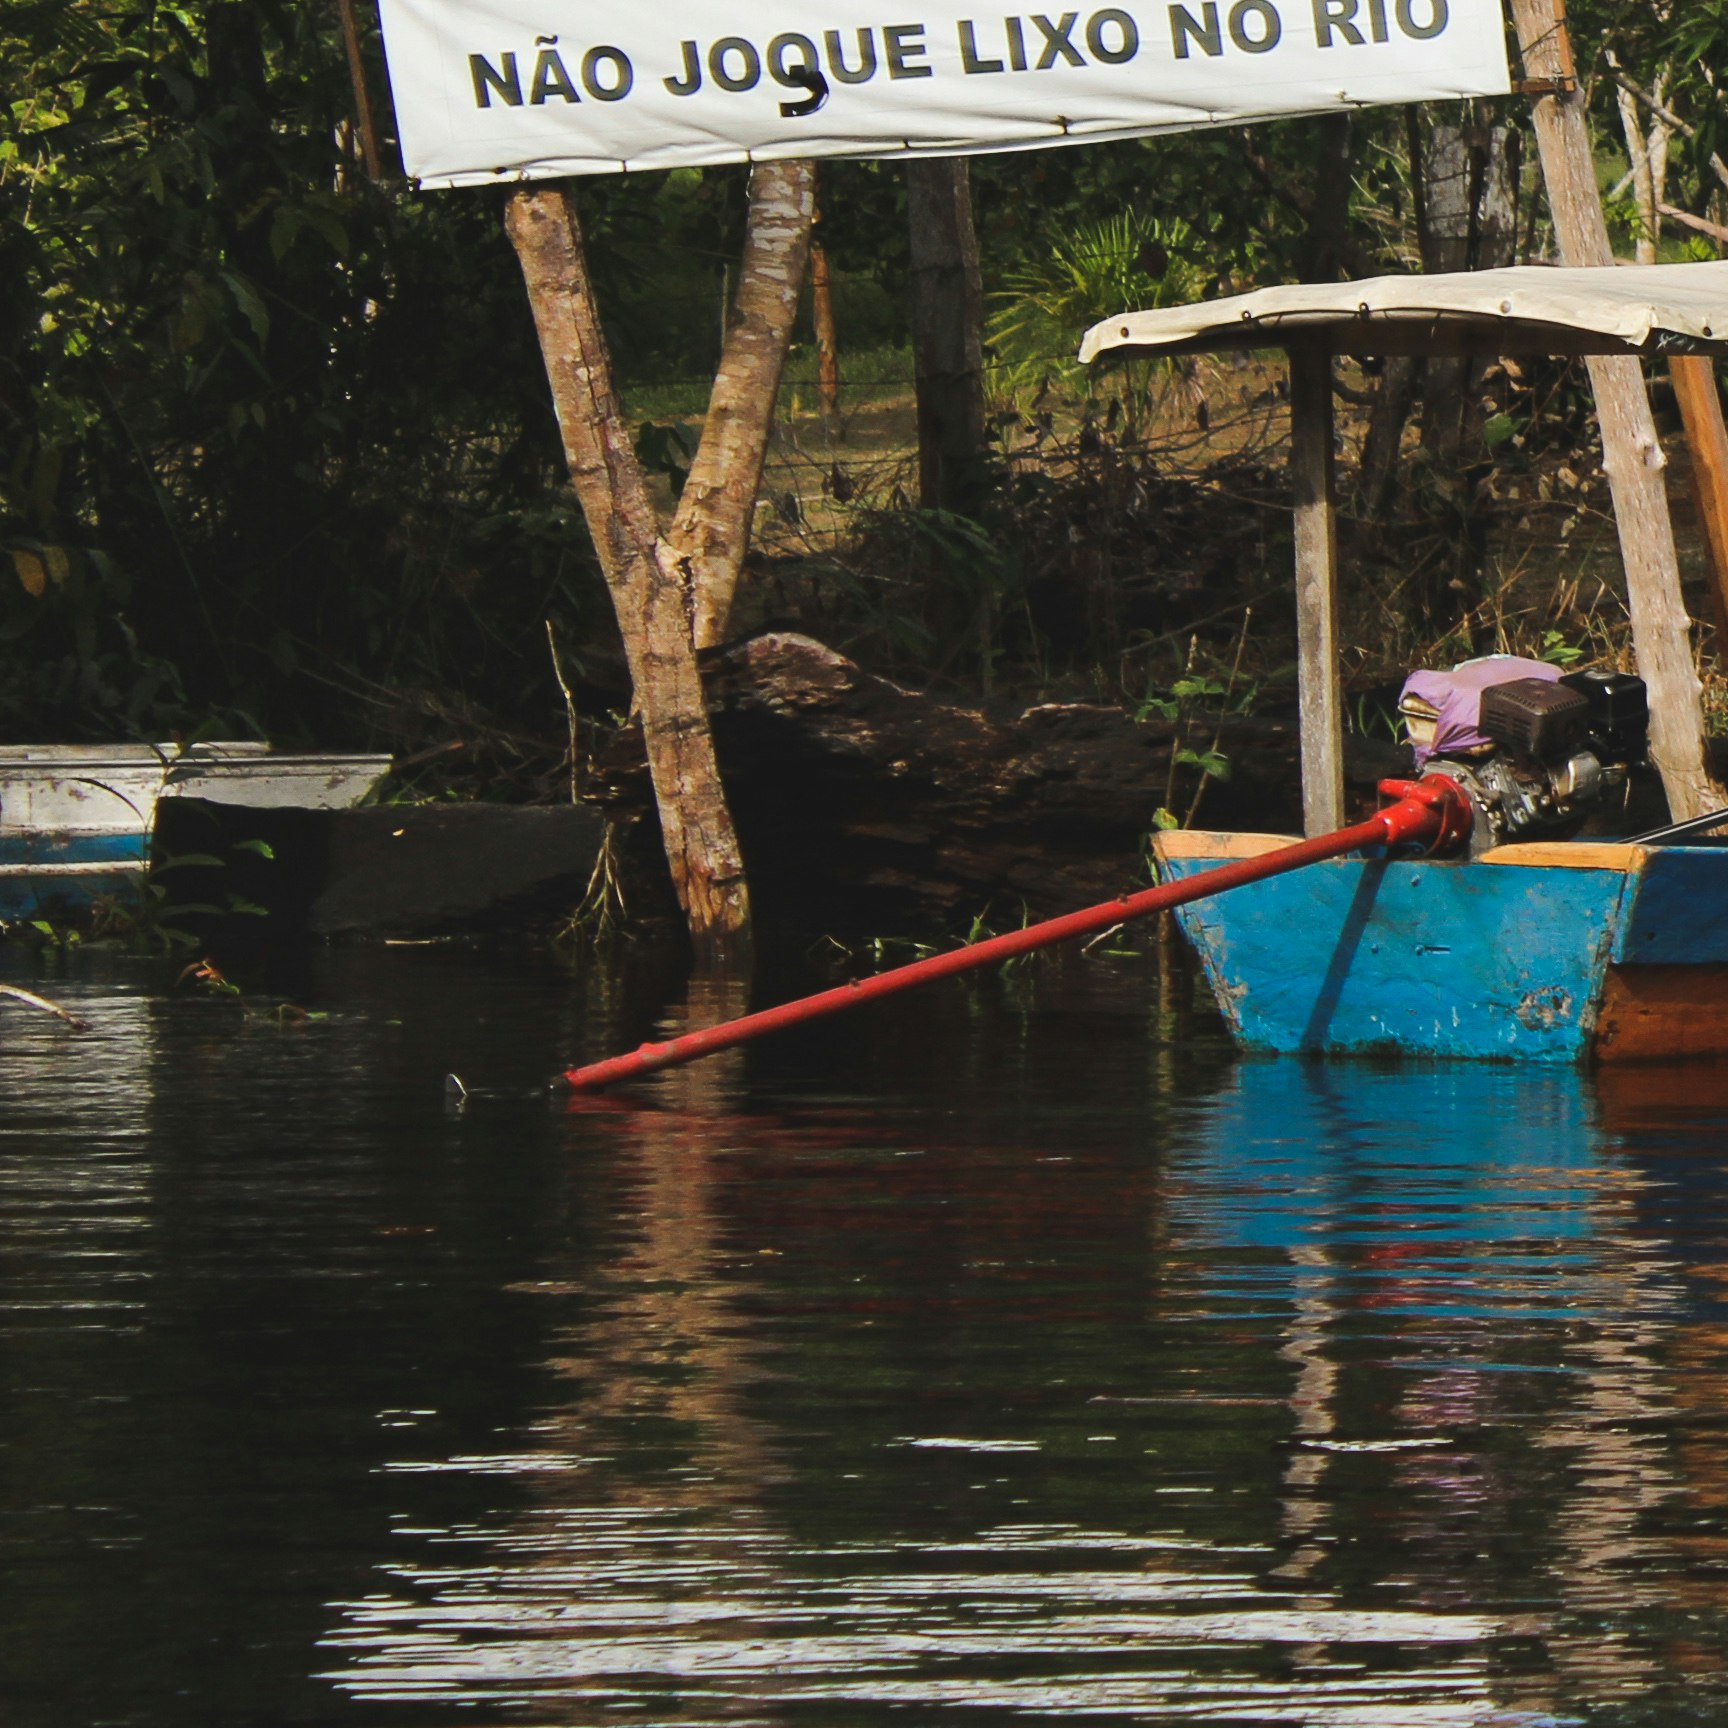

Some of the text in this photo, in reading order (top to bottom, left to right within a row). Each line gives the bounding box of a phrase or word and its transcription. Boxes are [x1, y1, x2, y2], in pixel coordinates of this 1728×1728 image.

[469, 35, 633, 108] NÃO
[664, 24, 932, 117] JOQUE
[958, 9, 1139, 74] LIXO
